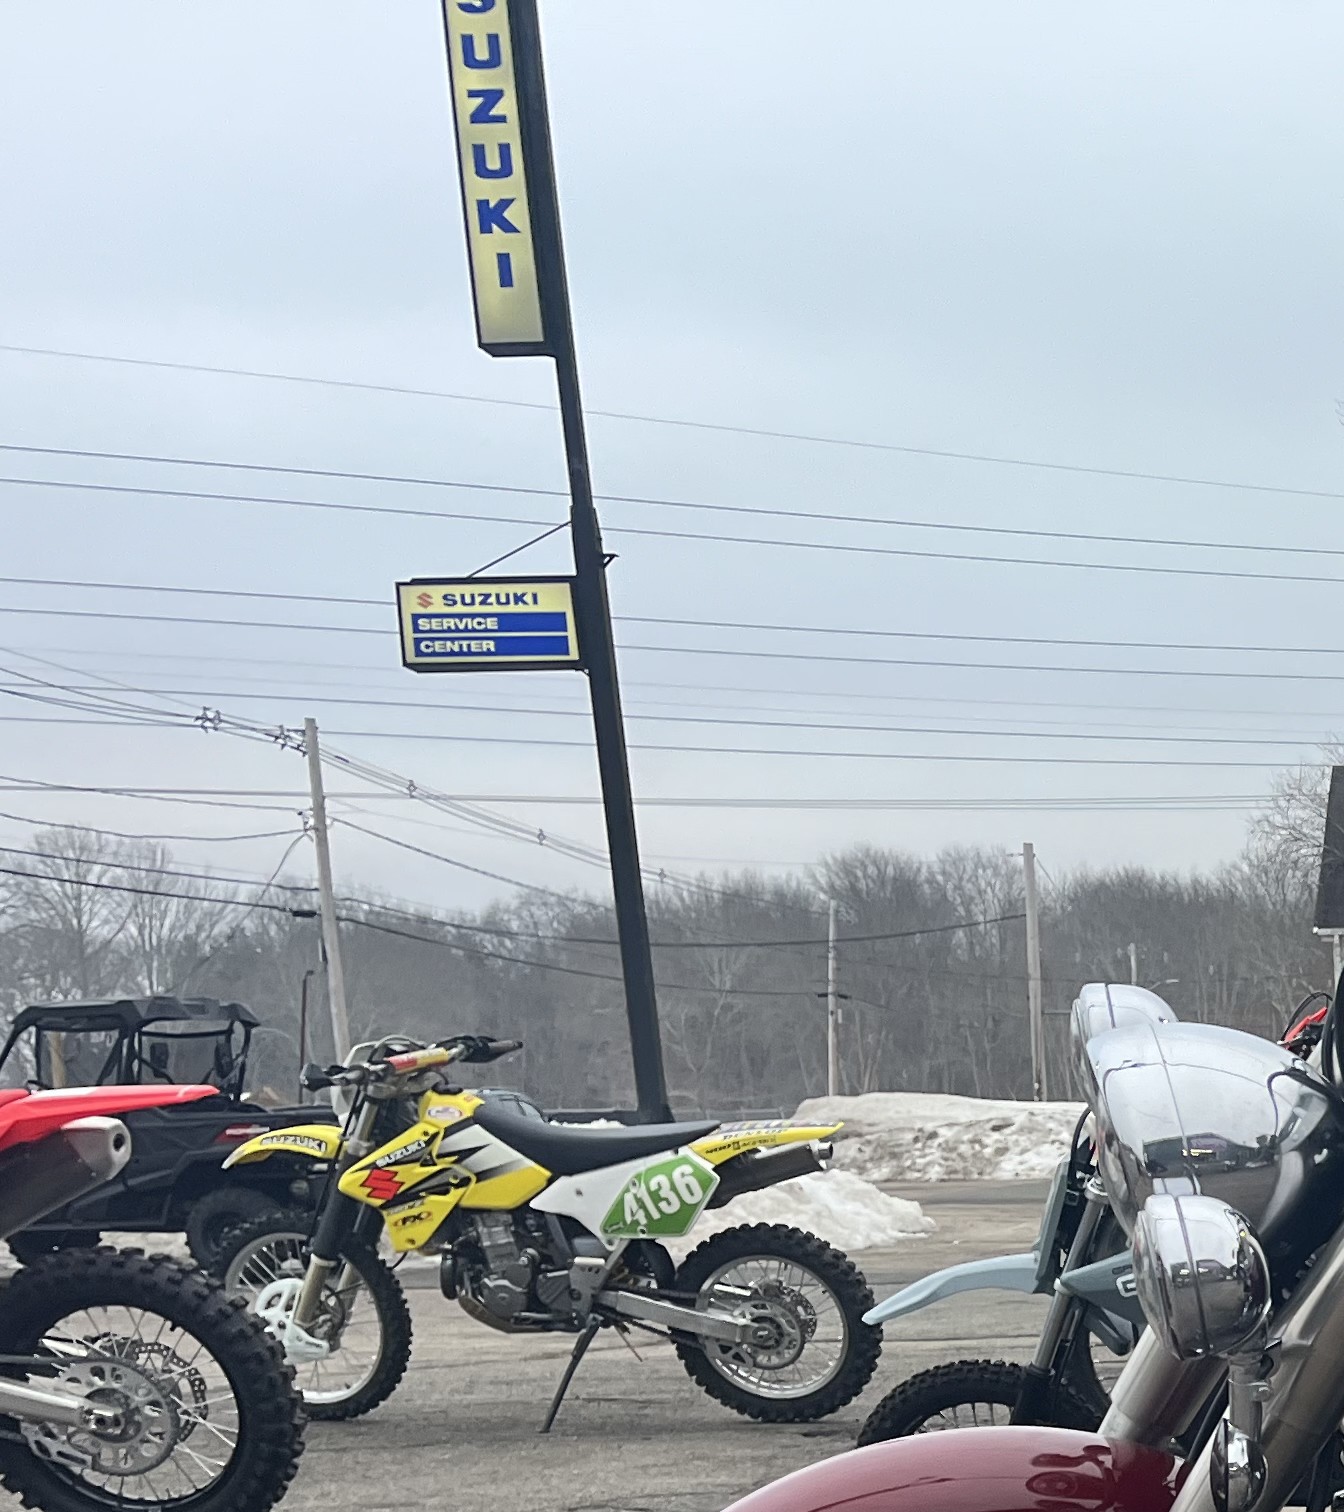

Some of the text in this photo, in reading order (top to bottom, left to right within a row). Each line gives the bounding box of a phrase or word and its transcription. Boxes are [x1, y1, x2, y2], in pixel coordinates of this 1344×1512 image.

[441, 592, 539, 606] SUZUKI
[417, 617, 499, 631] SERVICE
[419, 640, 496, 653] CENTER
[260, 1134, 327, 1154] SUZUKI
[375, 1140, 427, 1168] SUZUKI
[623, 1163, 703, 1227] 4136
